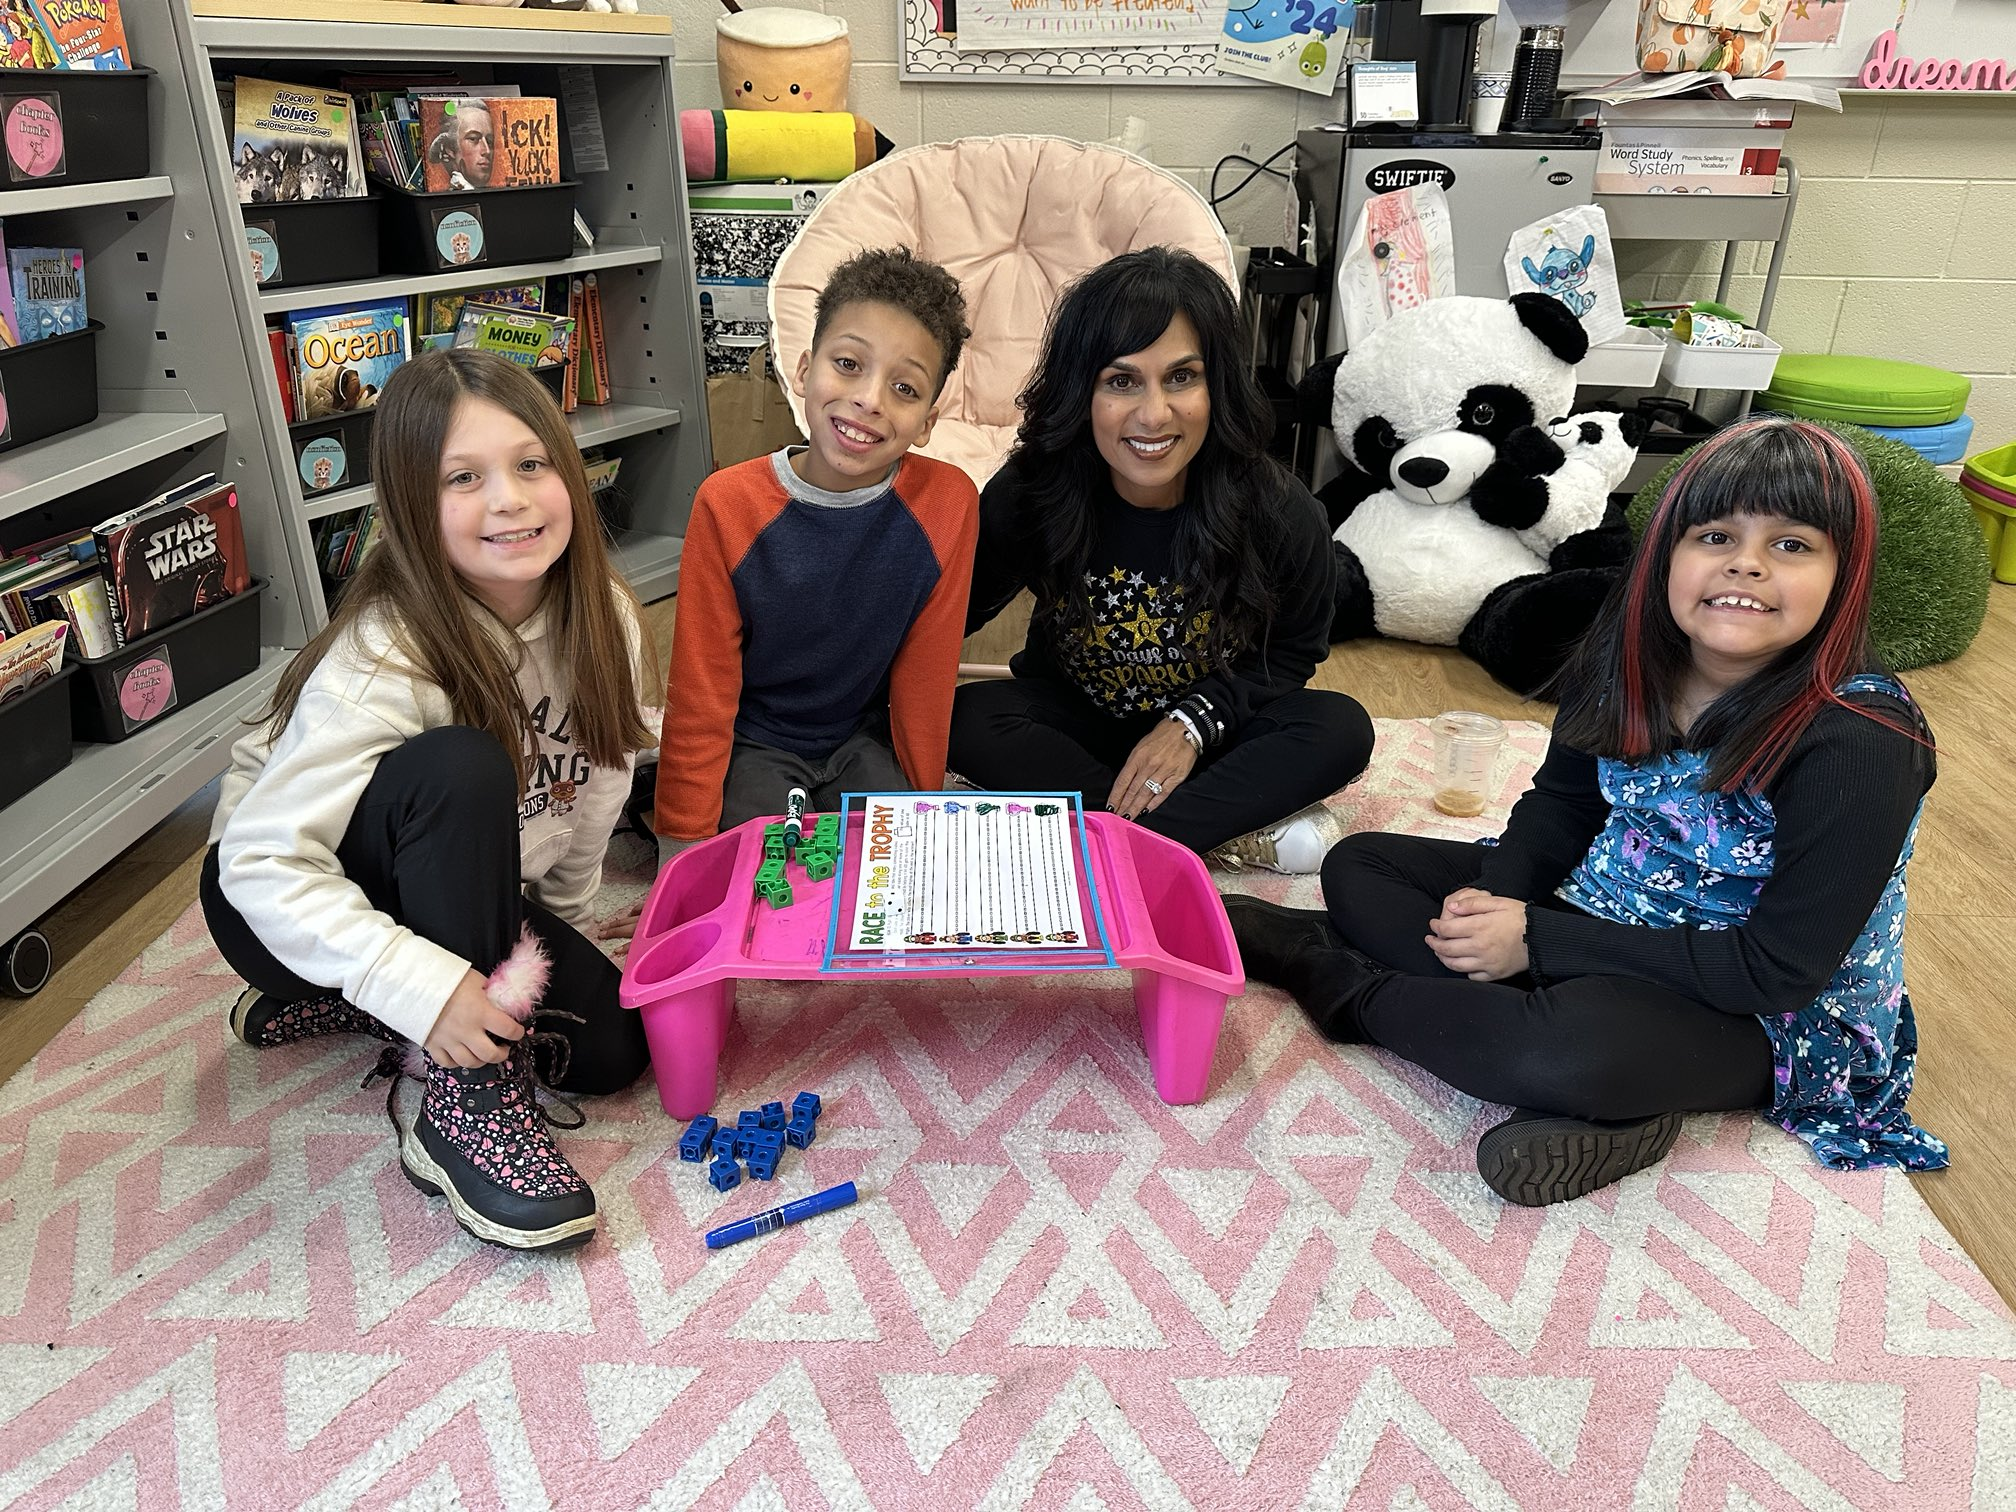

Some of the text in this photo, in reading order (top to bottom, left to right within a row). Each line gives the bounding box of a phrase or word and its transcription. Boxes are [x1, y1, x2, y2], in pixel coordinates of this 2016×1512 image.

[69, 27, 102, 49] Four-Star
[67, 42, 101, 64] Challenge
[1224, 47, 1241, 56] JOIN
[1241, 51, 1253, 59] THE
[1253, 54, 1272, 63] CLUB!
[277, 92, 283, 100] A
[284, 93, 303, 103] Pack
[303, 96, 315, 104] of
[16, 104, 56, 122] chapter
[270, 103, 319, 122] Wolves
[19, 121, 51, 138] books
[256, 120, 268, 128] and
[269, 122, 288, 131] Other
[289, 125, 310, 133] Canine
[1611, 148, 1674, 162] Word Study
[1628, 160, 1685, 178] System
[1700, 162, 1728, 170] Vocabulary
[1374, 170, 1445, 187] SWIFTIE
[32, 260, 61, 274] HEROES
[23, 266, 80, 300] TRAINING
[589, 289, 601, 342] Elementary
[488, 326, 541, 347] MONEY
[304, 329, 400, 369] Ocean
[144, 513, 217, 558] STAR
[146, 532, 217, 581] WARS
[105, 580, 119, 620] STAR
[129, 664, 164, 680] chapter
[132, 678, 160, 692] books
[870, 805, 895, 862] TROPHY
[867, 866, 889, 890] the
[865, 893, 883, 908] to
[859, 912, 885, 945] RACE
